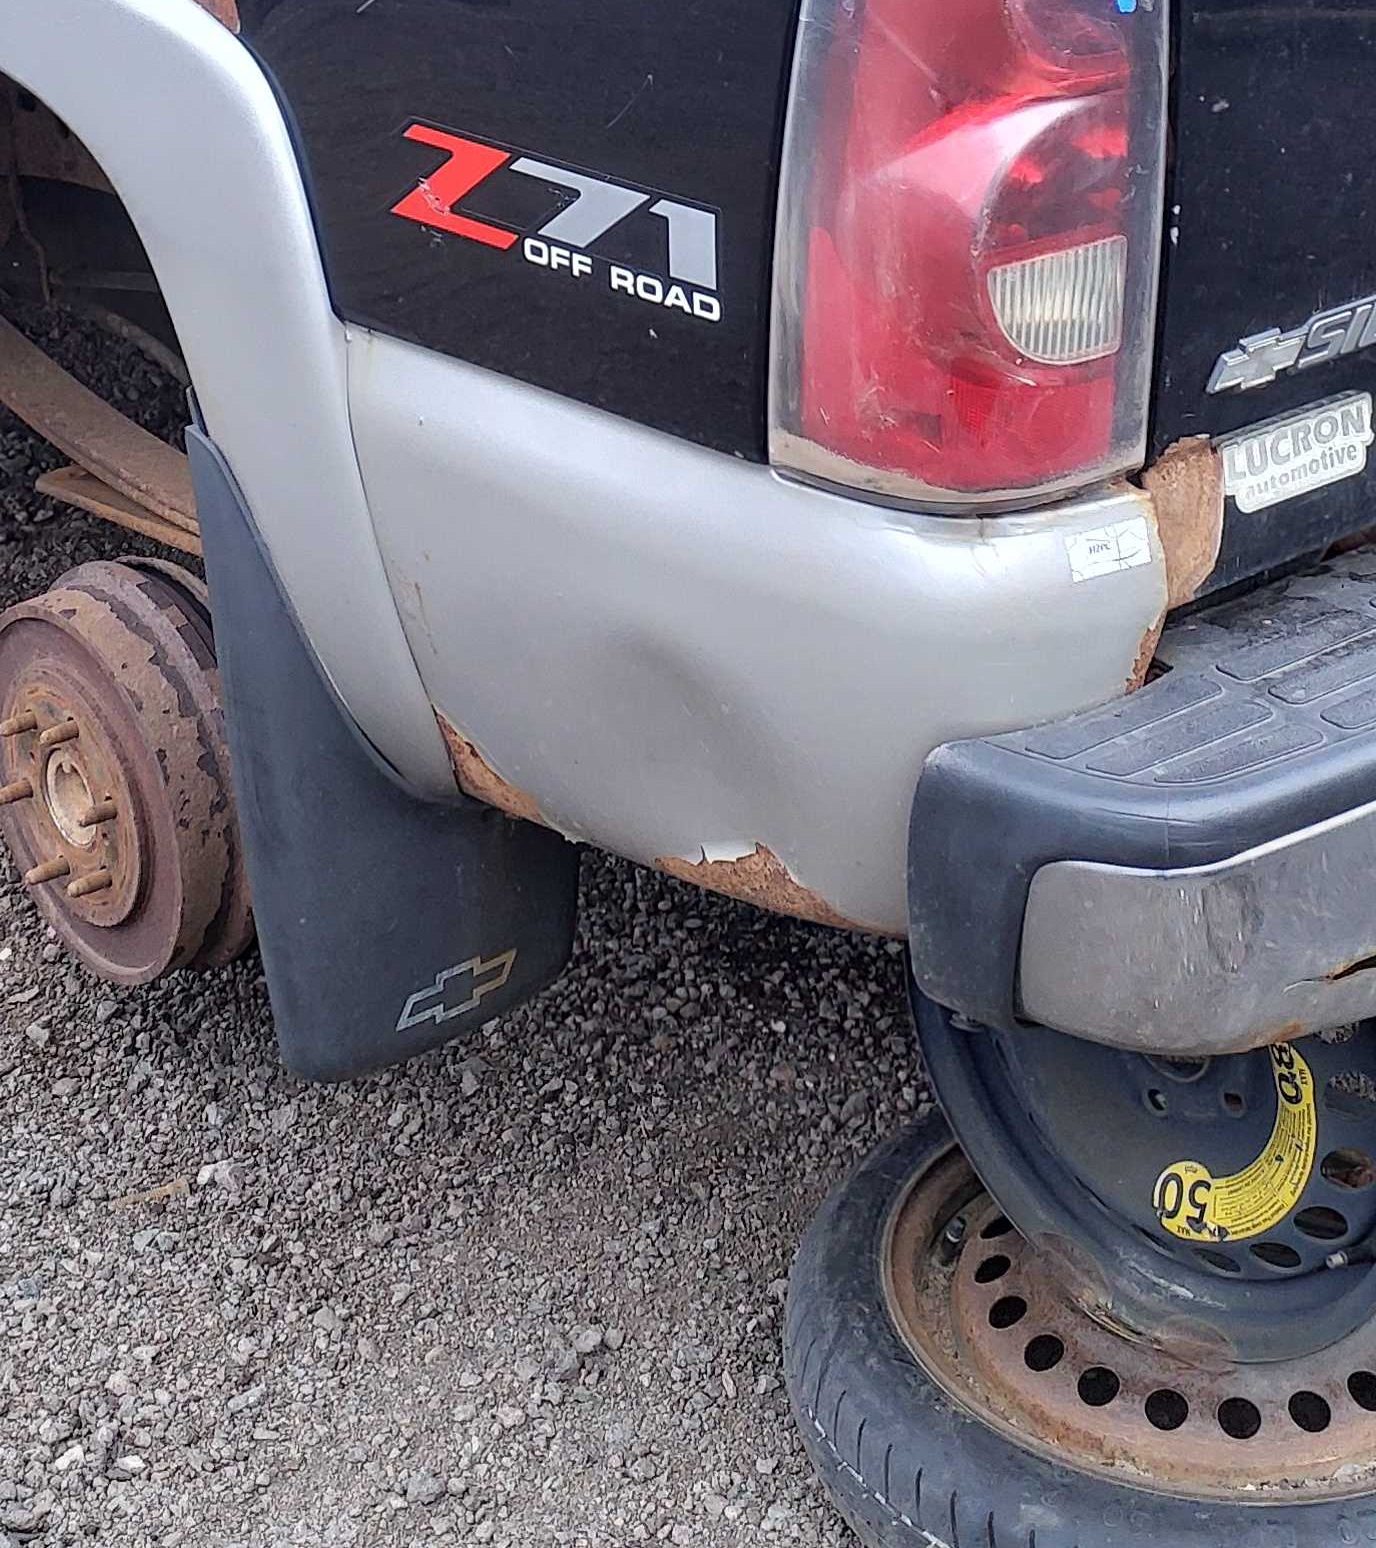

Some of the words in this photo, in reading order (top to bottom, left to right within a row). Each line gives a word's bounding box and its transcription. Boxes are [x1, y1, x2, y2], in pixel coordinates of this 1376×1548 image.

[390, 123, 718, 291] Z71
[523, 237, 593, 278] OFF
[610, 265, 722, 323] ROAD
[1225, 401, 1370, 483] LUCRON
[1243, 441, 1359, 505] automotive
